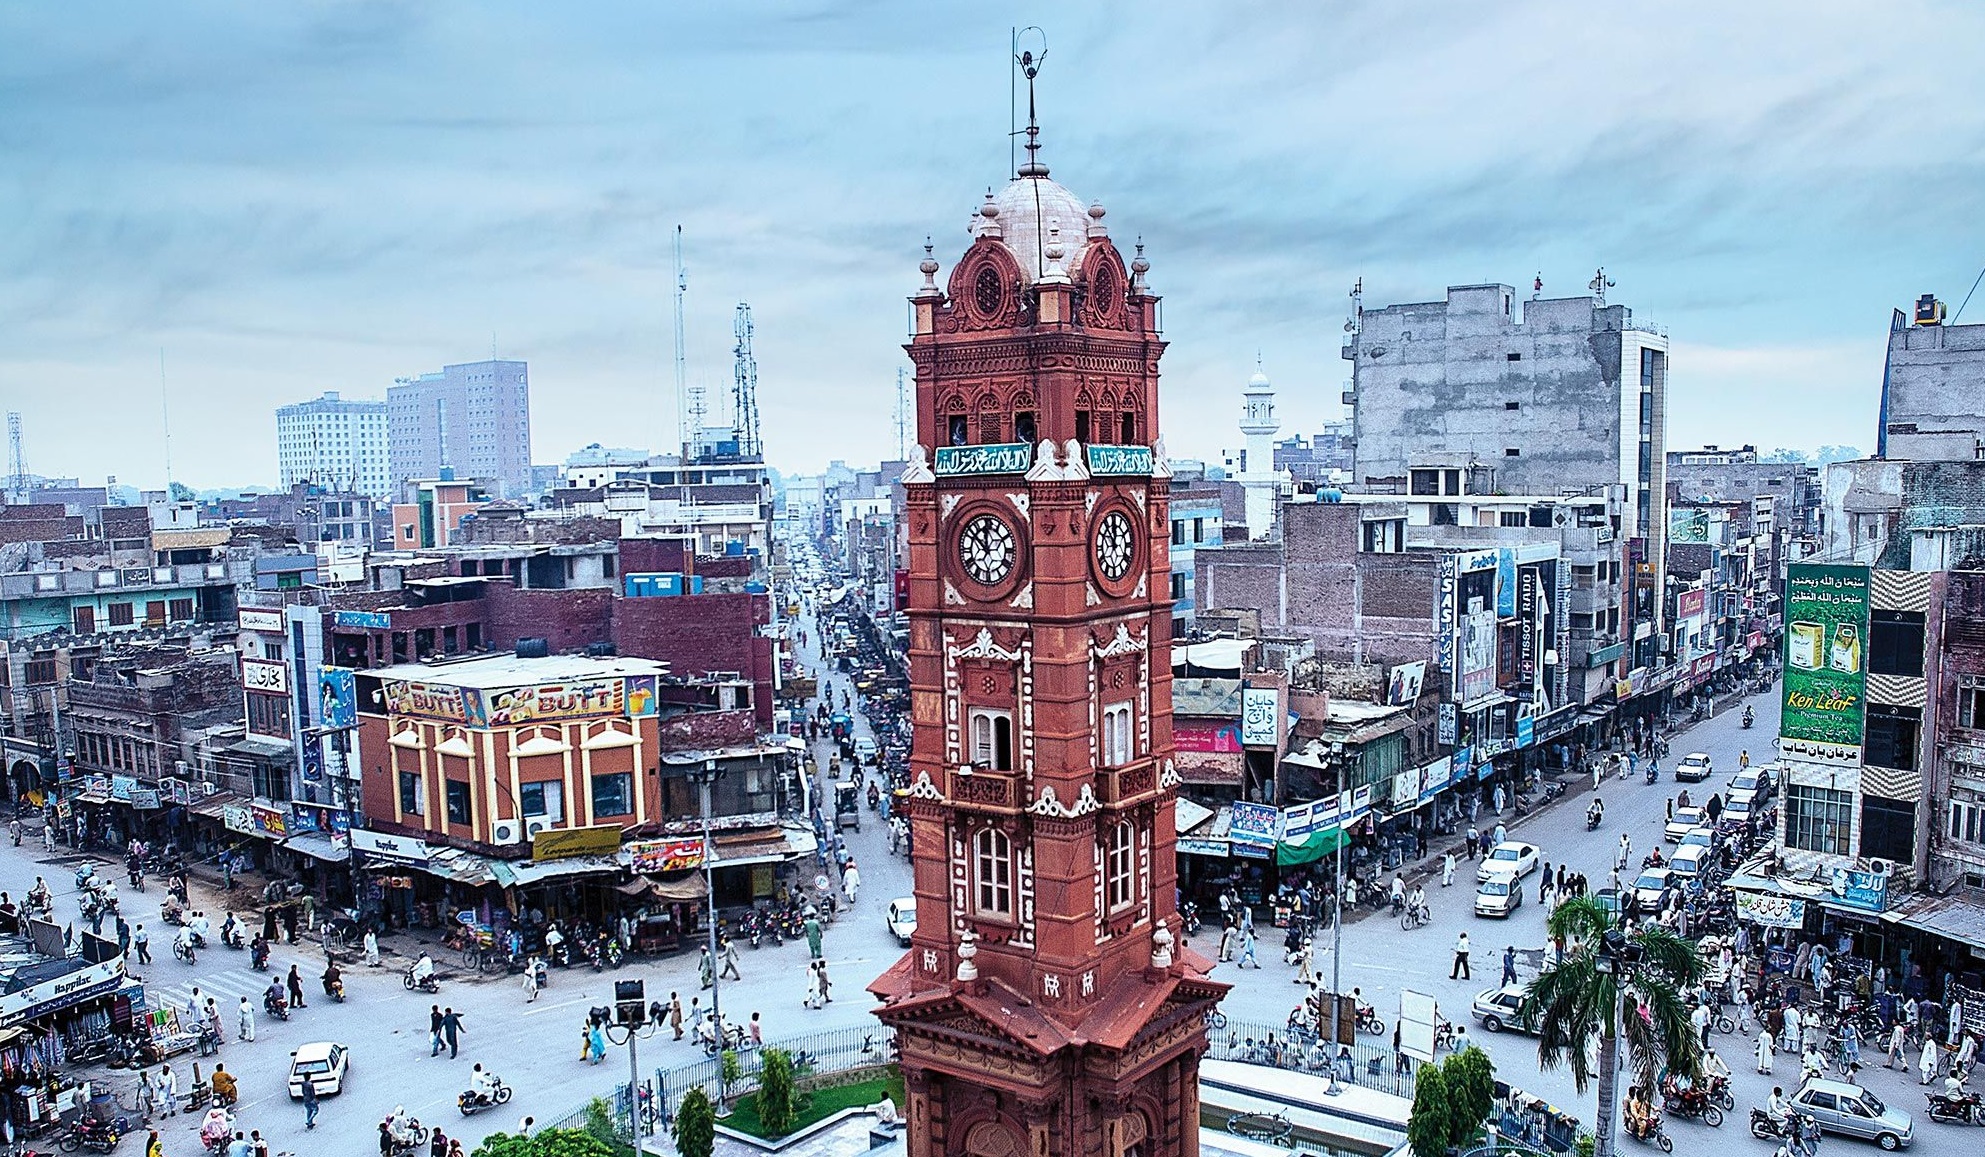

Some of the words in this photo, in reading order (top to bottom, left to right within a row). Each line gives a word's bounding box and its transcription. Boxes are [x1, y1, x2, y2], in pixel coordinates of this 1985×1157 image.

[1521, 573, 1531, 611] RADO
[1684, 594, 1701, 612] Bata
[1521, 617, 1531, 658] TISSOT
[1695, 657, 1712, 676] Bata
[412, 692, 455, 714] BUTT
[538, 689, 611, 713] BUTT
[1247, 694, 1274, 711] جاپان
[1787, 691, 1814, 708] Ken
[1815, 693, 1856, 711] Leaf
[1247, 709, 1273, 725] واچ
[1800, 711, 1829, 720] Premium
[1245, 726, 1275, 742] کمپنی
[1782, 742, 1808, 756] شاپ
[1808, 745, 1826, 760] پان
[1826, 746, 1858, 761] عرفان
[54, 975, 92, 995] Happilac
